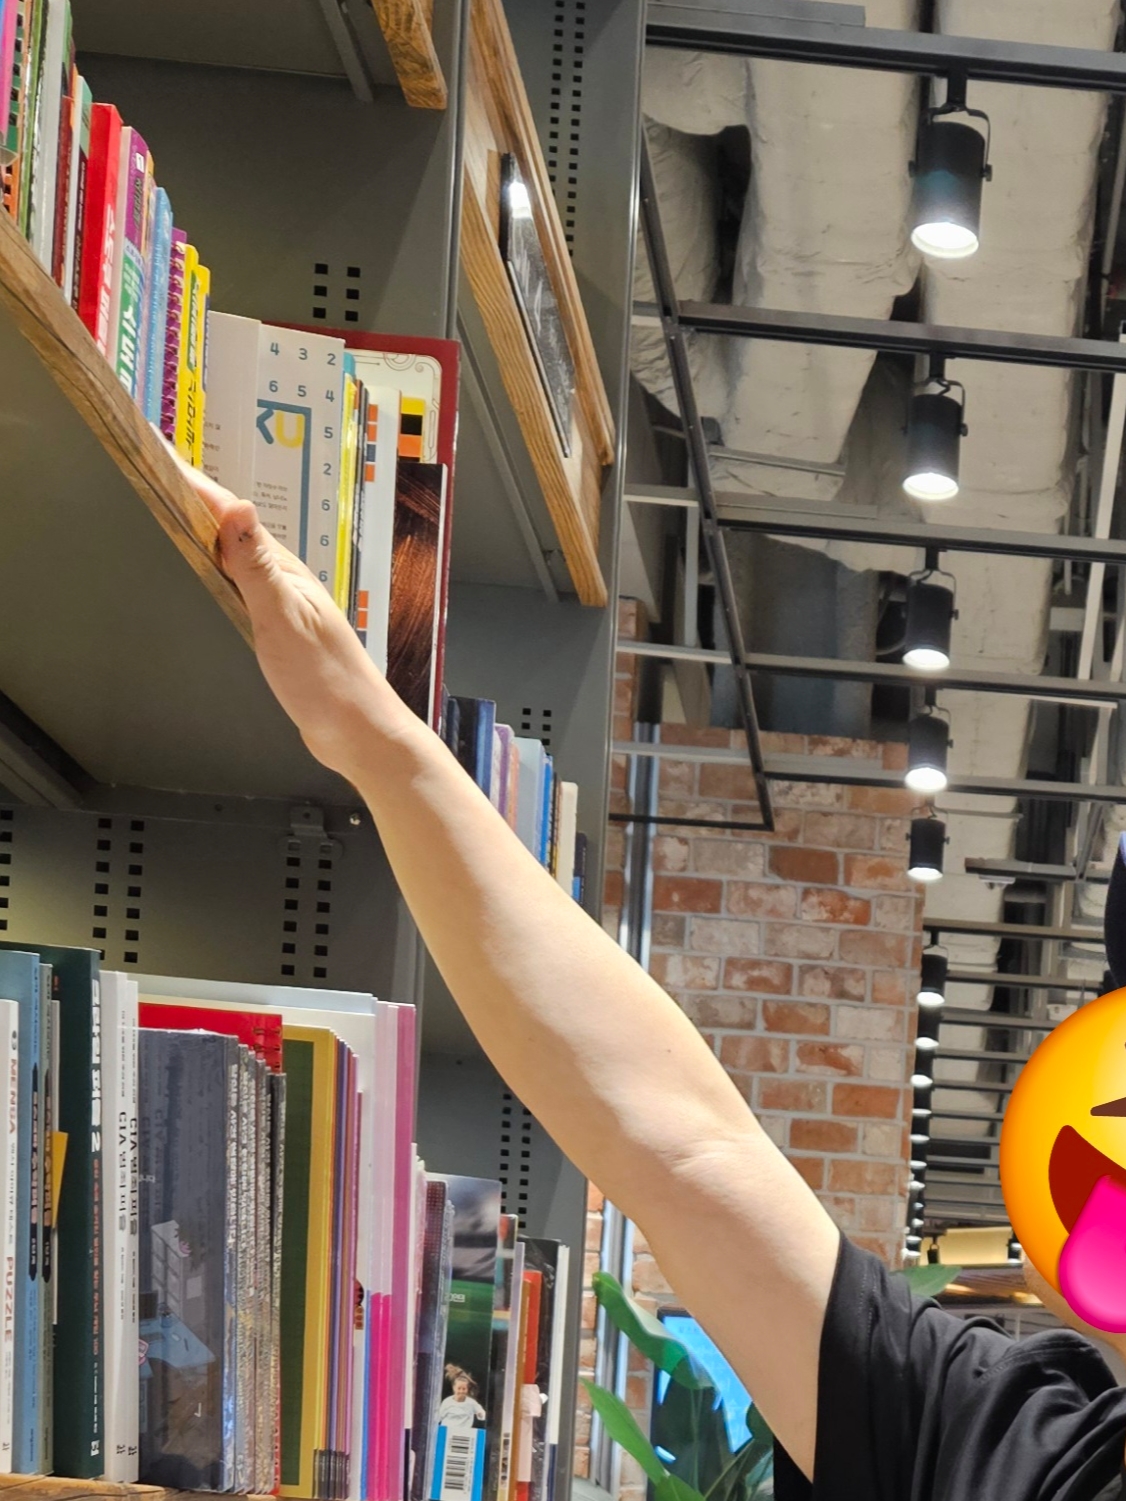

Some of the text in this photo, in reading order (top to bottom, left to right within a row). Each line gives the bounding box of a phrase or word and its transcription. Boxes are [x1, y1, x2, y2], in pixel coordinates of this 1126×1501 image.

[269, 343, 336, 366] 4 3 2
[269, 380, 335, 402] 6 5 4
[323, 427, 333, 439] 5
[322, 463, 332, 475] 2
[321, 500, 330, 511] 6
[320, 535, 330, 546] 6
[318, 571, 328, 582] 6
[91, 1132, 101, 1153] 2
